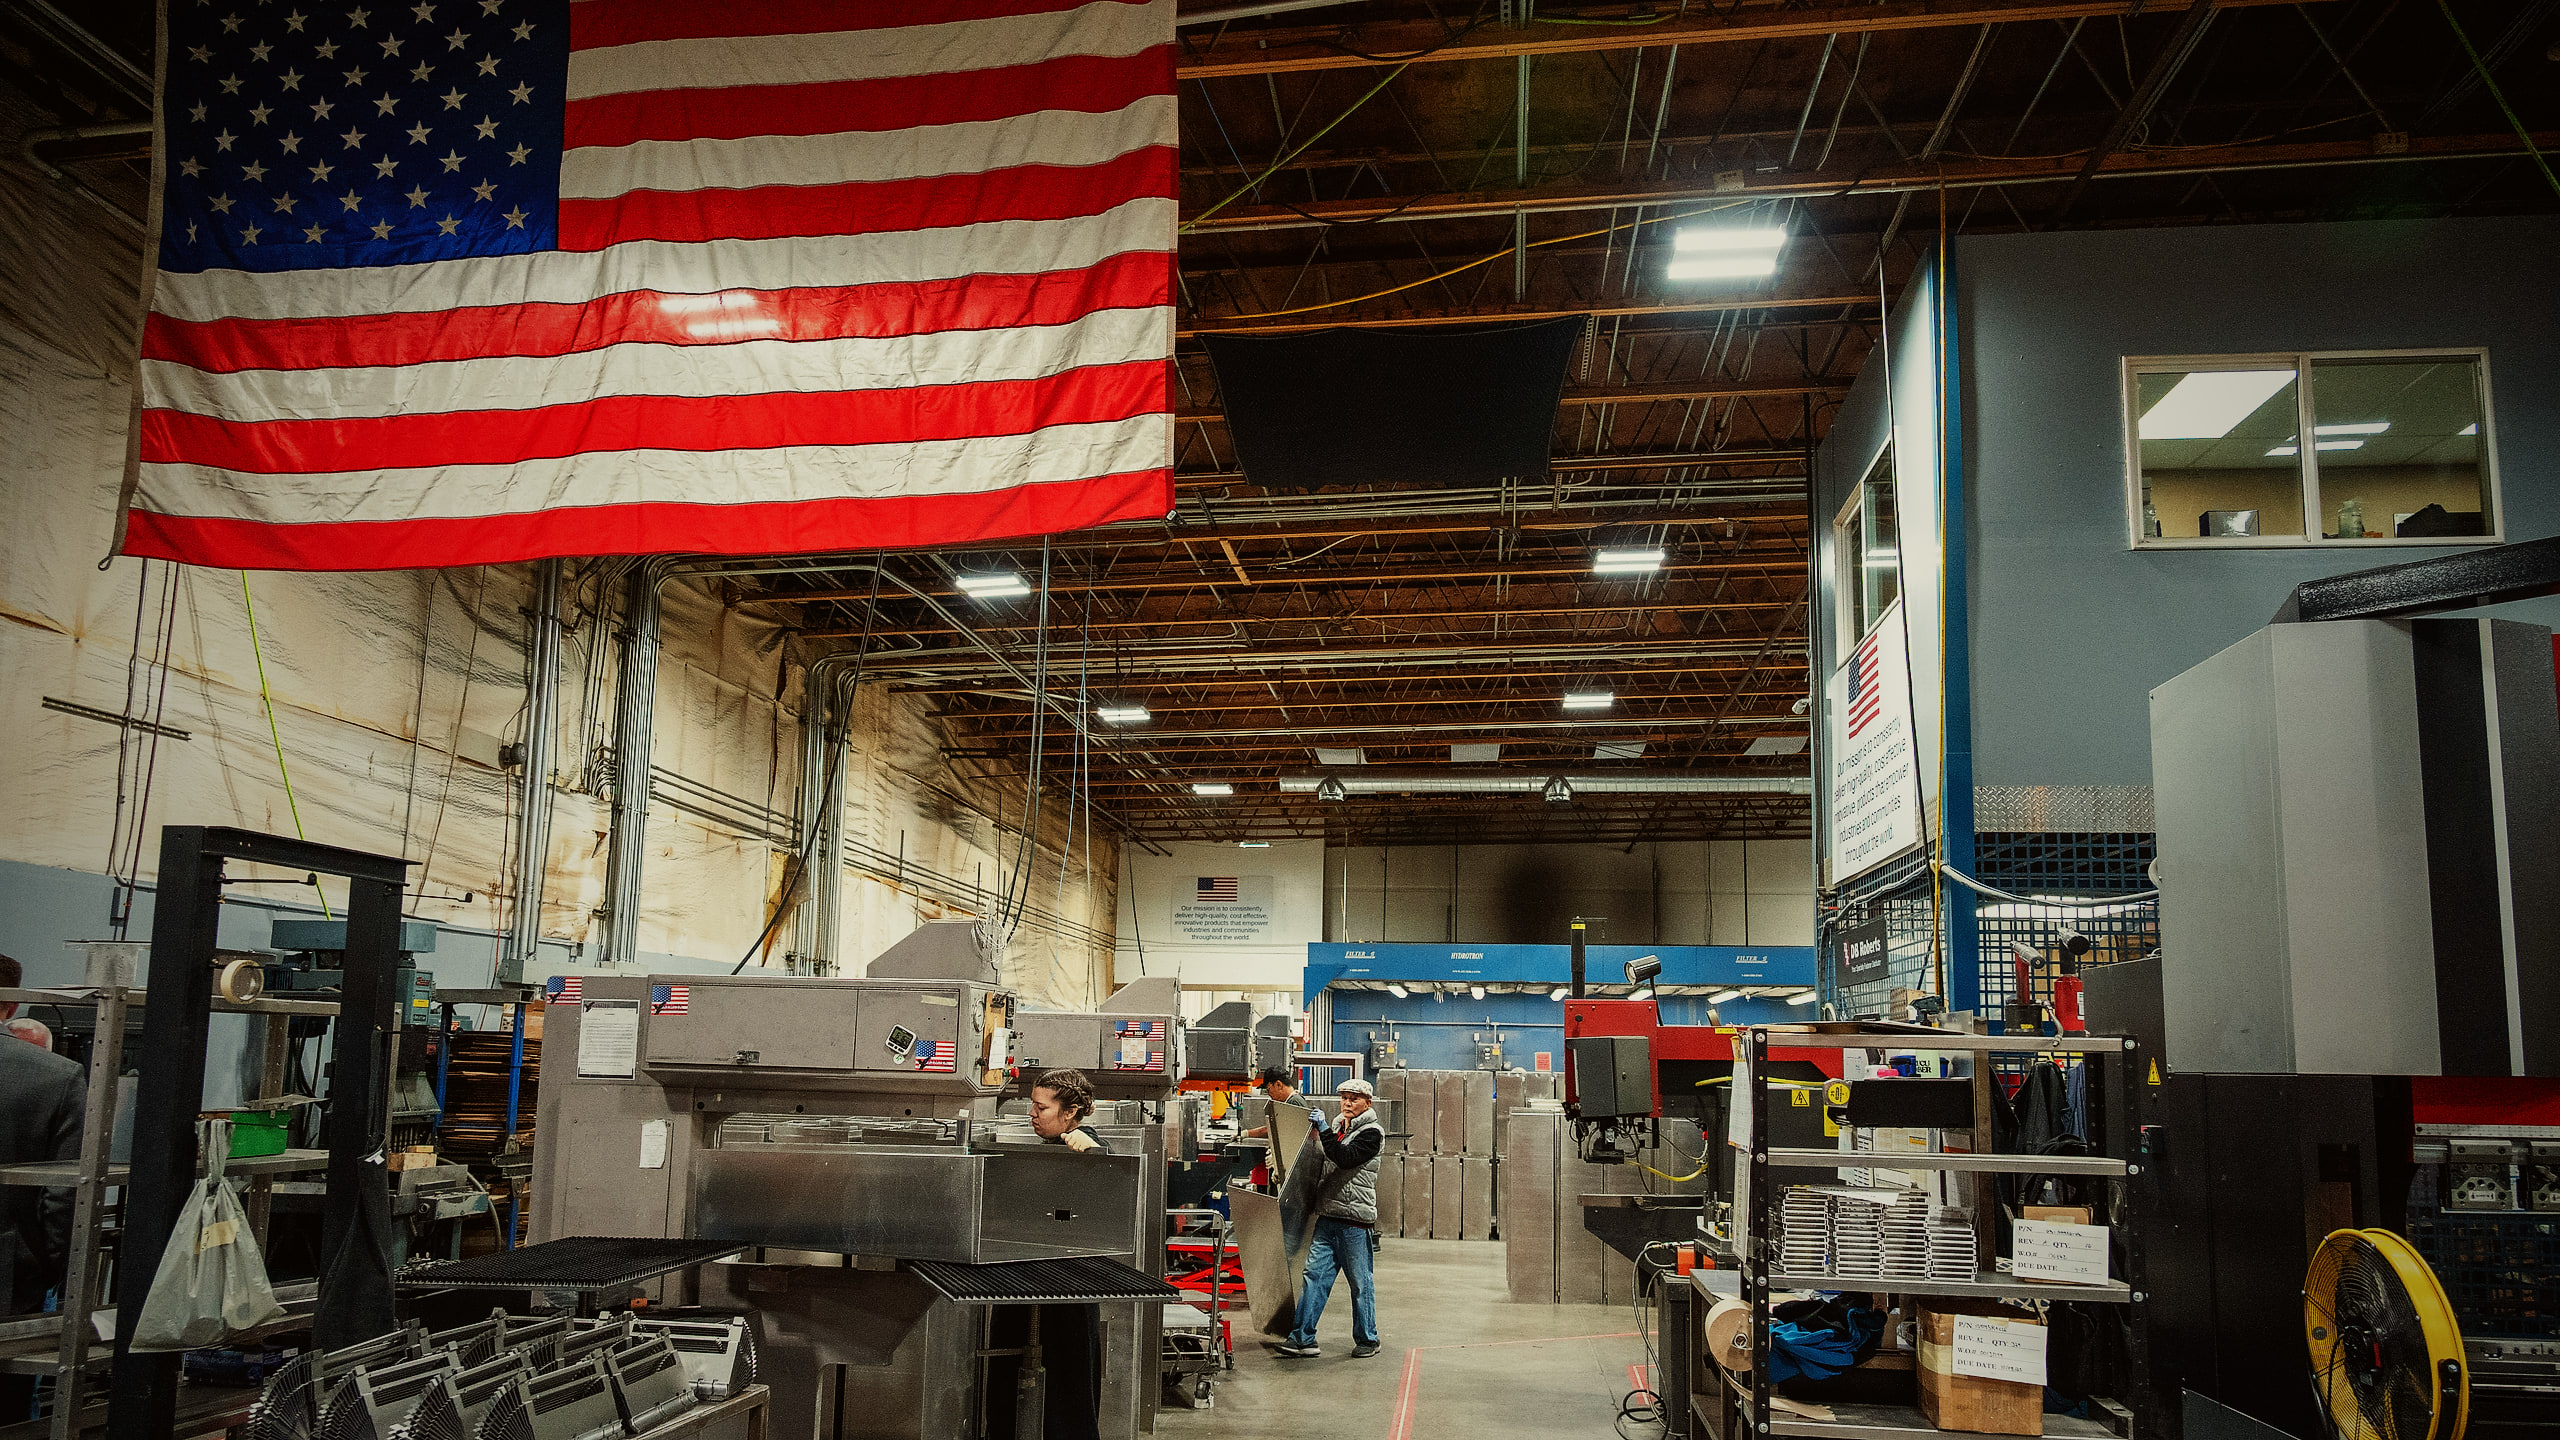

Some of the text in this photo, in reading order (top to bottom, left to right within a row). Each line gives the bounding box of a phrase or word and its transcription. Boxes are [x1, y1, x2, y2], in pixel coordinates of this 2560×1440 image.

[1229, 905, 1263, 913] consistently
[1850, 936, 1880, 959] DB Roberts
[2018, 1225, 2033, 1233] P/N
[2036, 1263, 2058, 1271] DATE
[1958, 1321, 1973, 1329] P/N
[1957, 1359, 1974, 1367] DUE
[1976, 1361, 1997, 1370] DATE
